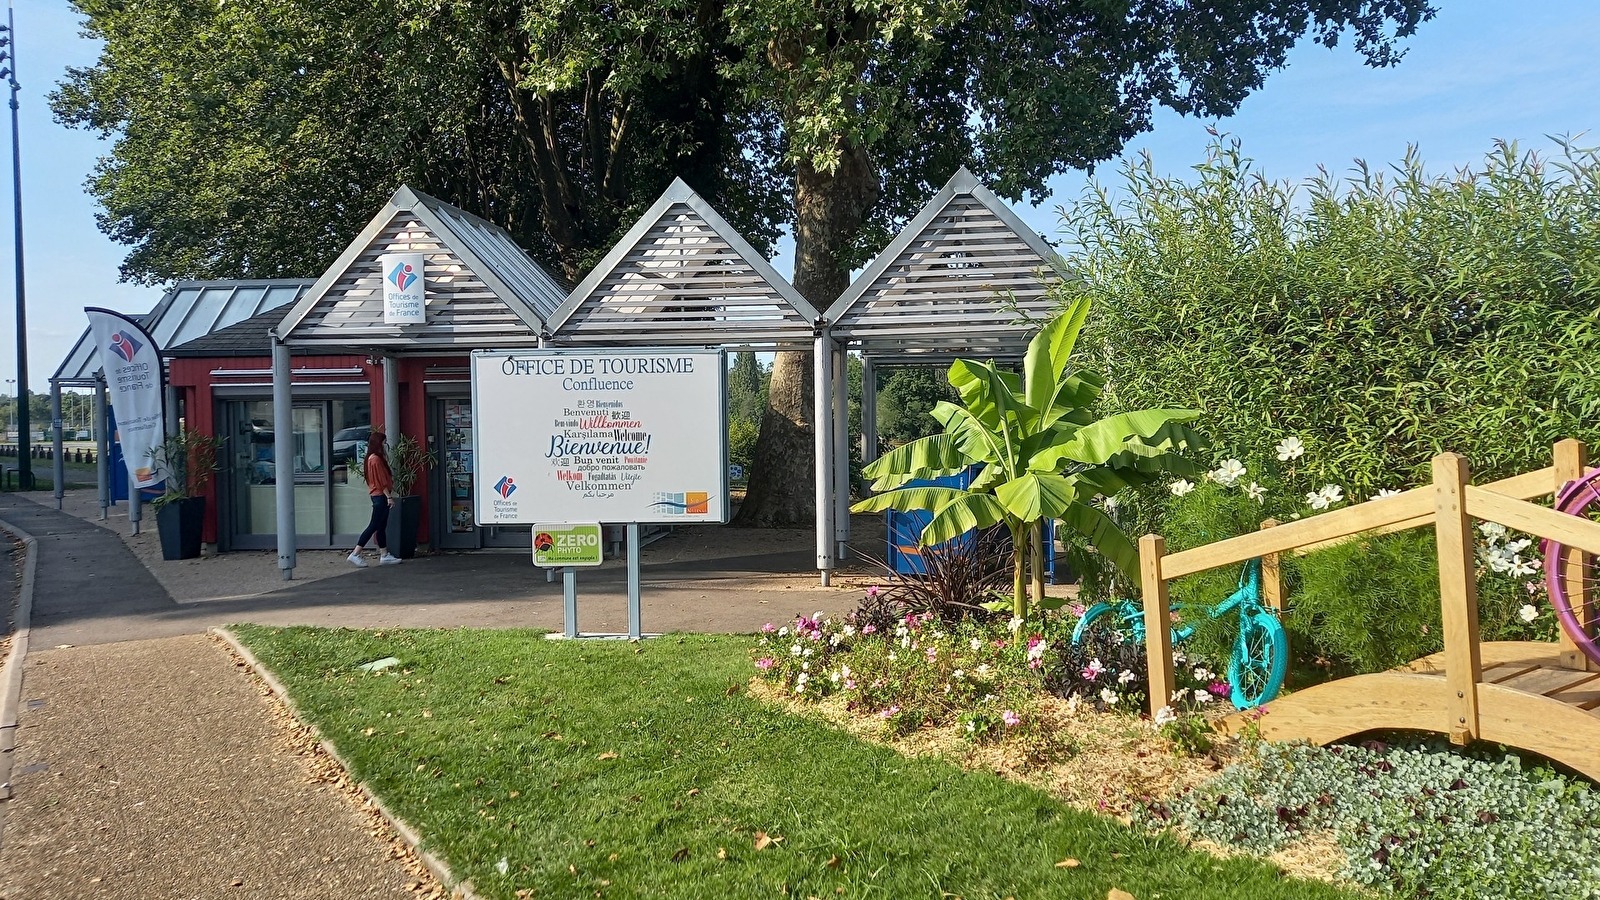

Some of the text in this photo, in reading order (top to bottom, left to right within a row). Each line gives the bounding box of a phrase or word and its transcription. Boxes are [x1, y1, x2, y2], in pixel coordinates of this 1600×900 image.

[502, 357, 694, 375] OFFICE DE TOURISME
[562, 377, 634, 391] Confluence
[563, 407, 609, 416] Benvenuti
[579, 415, 643, 430] Willkommen
[563, 429, 613, 439] Karşılama
[613, 429, 647, 441] Welcome
[544, 434, 652, 458] Bienvenue!
[574, 456, 619, 464] Bun venit
[577, 464, 600, 472] добро
[556, 470, 583, 481] Welkom
[566, 481, 632, 490] Velkommen
[557, 534, 598, 546] ZERO
[557, 546, 582, 554] PHYTO
